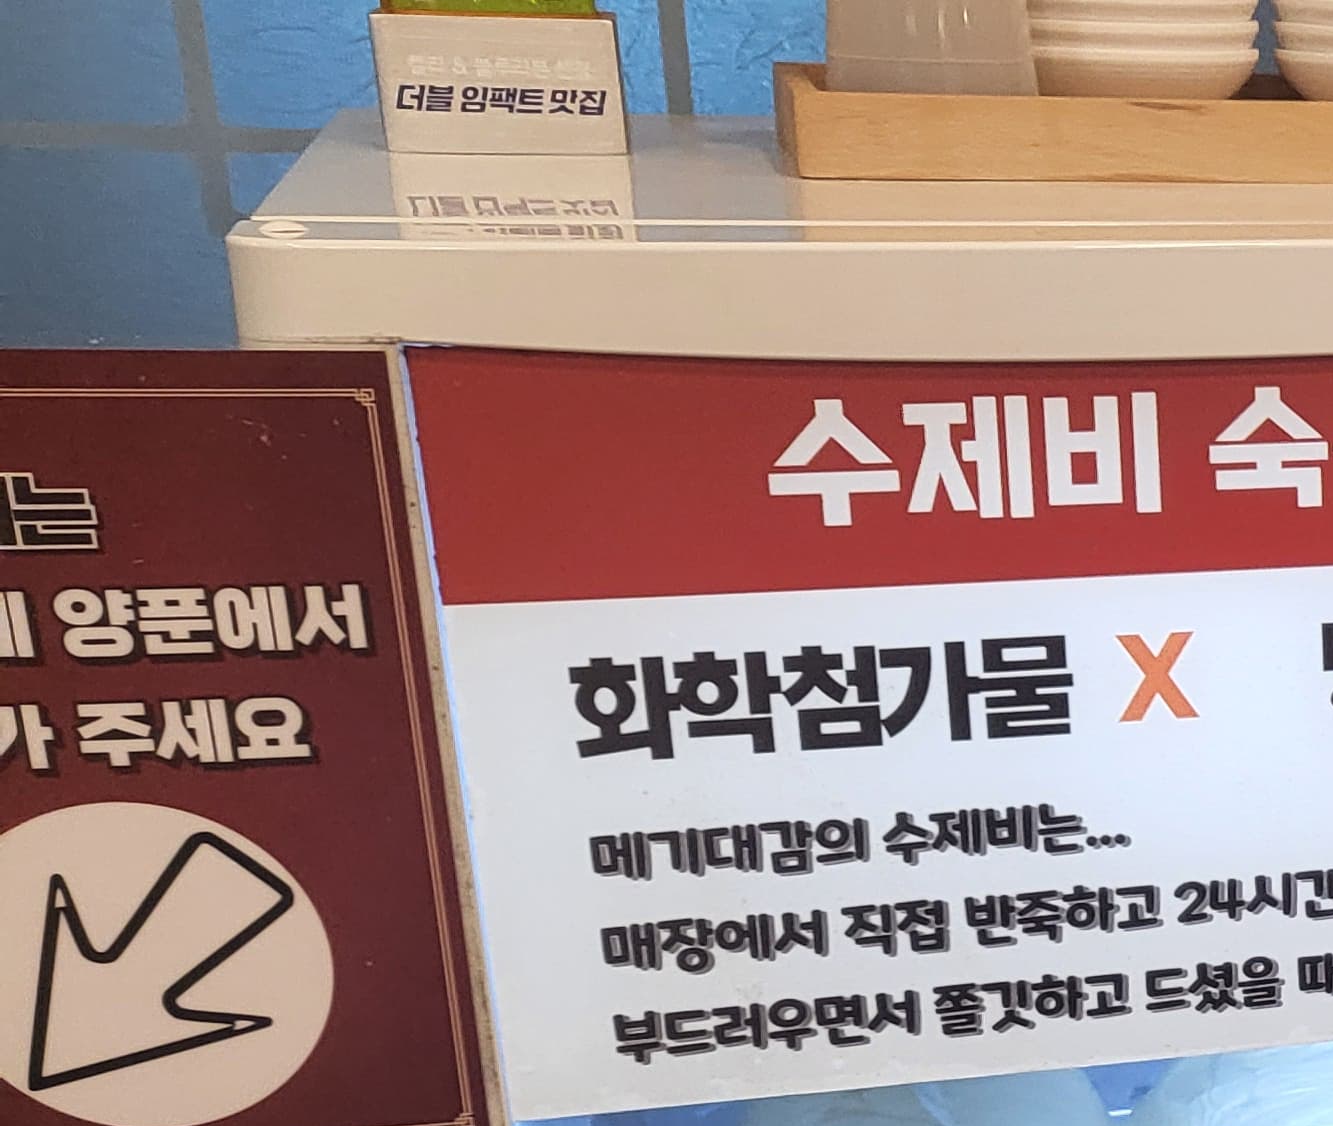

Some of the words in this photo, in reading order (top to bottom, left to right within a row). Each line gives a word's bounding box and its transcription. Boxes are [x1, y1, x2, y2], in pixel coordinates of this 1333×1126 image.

[396, 84, 454, 113] 더블
[460, 86, 545, 114] 임팩트
[549, 89, 608, 116] 맛집
[768, 391, 1162, 527] 수제비
[0, 472, 99, 551] 는
[52, 582, 378, 662] 양푼에서
[76, 696, 314, 770] 주세요
[568, 635, 1074, 760] 화학첨가물
[1116, 631, 1199, 722] X
[589, 817, 870, 881] 메기대감의
[882, 804, 1131, 864] 수제비는...
[600, 909, 828, 974] 매장에서
[841, 899, 951, 957] 직접
[965, 884, 1160, 946] 반죽하고
[613, 990, 921, 1065] 부드러우면서
[933, 973, 1131, 1038] 쫄깃하고
[1144, 955, 1284, 1011] 드셨을
